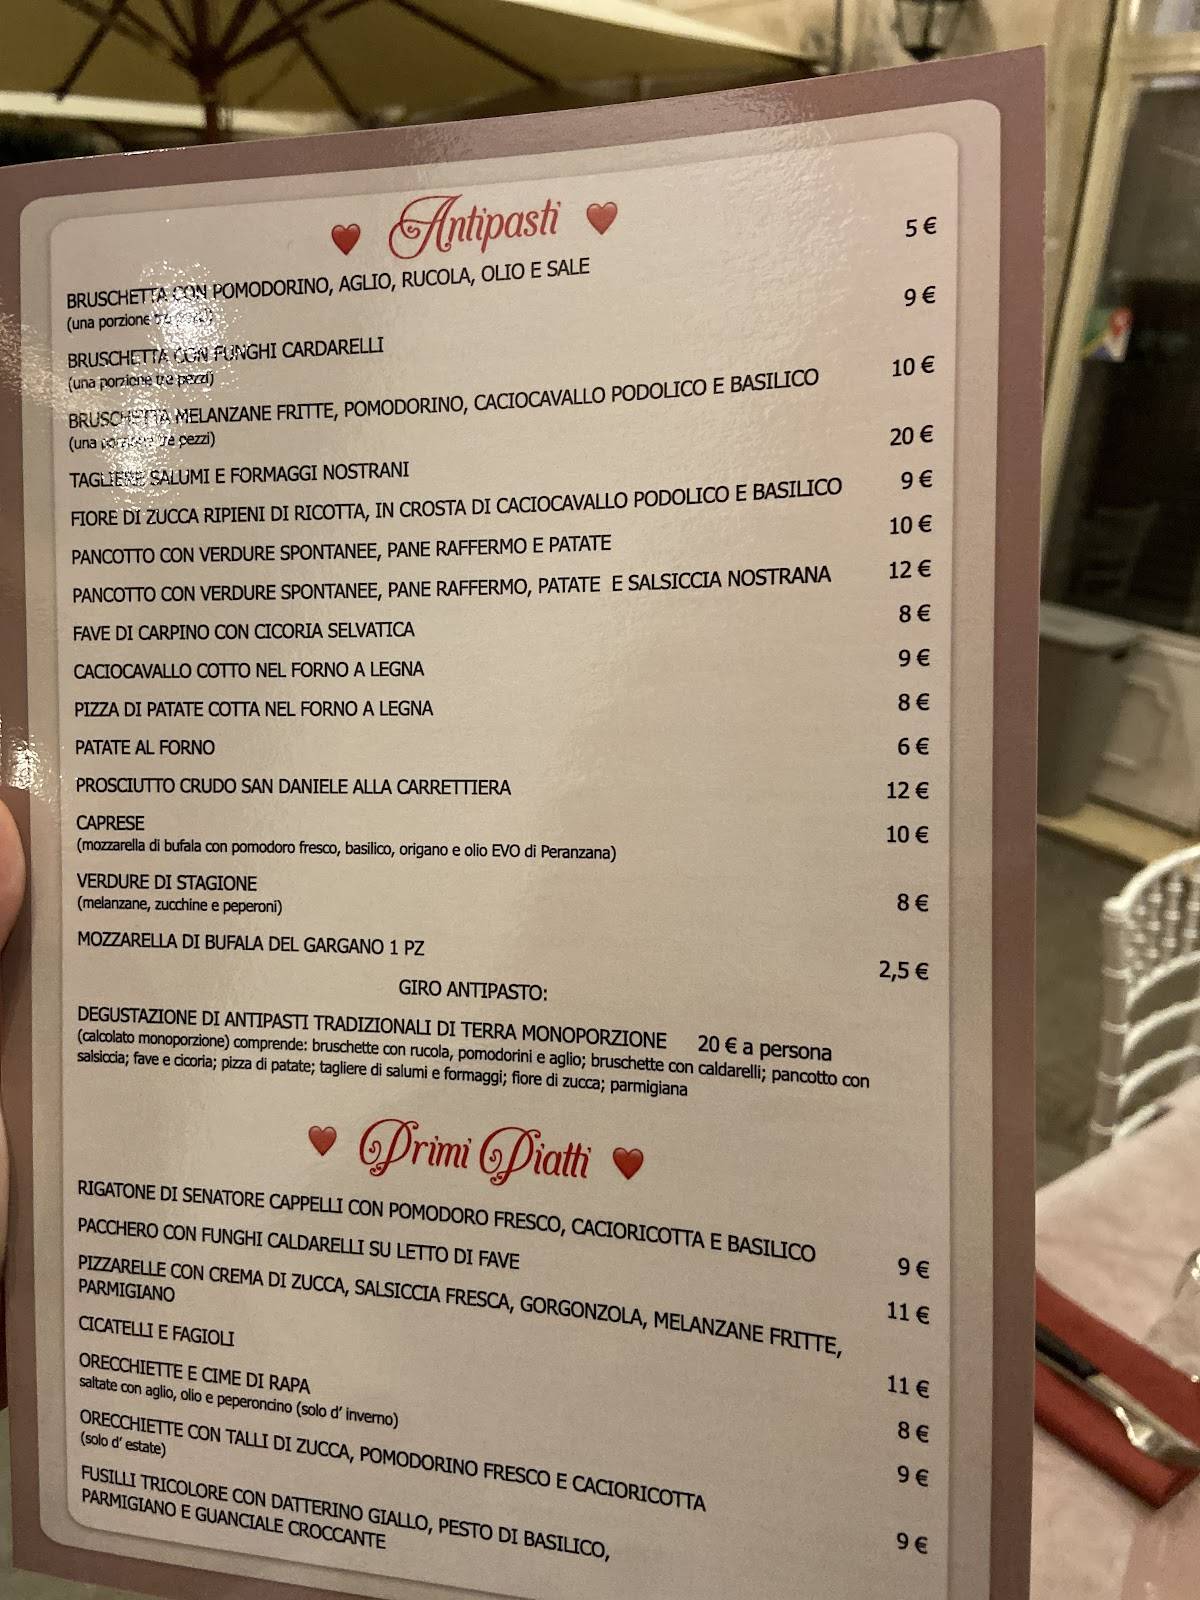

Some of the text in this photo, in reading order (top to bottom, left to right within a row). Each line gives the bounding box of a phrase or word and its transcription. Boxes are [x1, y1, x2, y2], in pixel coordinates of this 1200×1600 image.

[388, 193, 562, 260] Antipasti
[905, 215, 938, 238] 5 €
[66, 256, 591, 310] BRUSCHETTA CON POMODORINO, AGLIO, RUCOLA, OLIO E SALE
[891, 354, 935, 378] 10 €
[70, 476, 843, 527] FIORE DI ZUCCA RIPIENI DI RICOTTA, IN CROSTA DI CACIOCAVALLO PODOLICO E BASILICO
[888, 558, 932, 580] 12 €
[72, 620, 416, 642] FAVE DI CARPINO CON CICORIA SELVATICA
[74, 699, 434, 718] PIZZA DI PATATE COTTA NEL FORNO A LEGNA
[897, 692, 930, 712] 8 €
[75, 776, 512, 796] PROSCIUTTO CRUDO SAN DANIELE ALLA CARRETTIERA
[75, 814, 145, 832] CAPRESE
[76, 836, 617, 864] (mozzarella di bufala con pomodoro fresco, basilico, origano e olio EVO di Peranzana)
[77, 894, 283, 917] (melanzane, zucchine e peperoni)
[77, 929, 425, 957] MOZZARELLA DI BUFALA DEL GARGANO 1 PZ
[878, 959, 929, 983] 2,5 €
[398, 978, 548, 1002] GIRO ANTIPASTO:
[77, 1004, 668, 1050] DEGUSTAZIONE DI ANTIPASTI TRADIZIONALI DI TERRA MONOPORZIONE
[697, 1034, 832, 1062] 20 € a persona
[76, 1048, 688, 1098] salsiccia; fave e cicoria; pizza di patate; tagliere di salumi e formaggi; fiore di zucca; parmigiana
[359, 1118, 592, 1186] Primi Piatti
[77, 1178, 816, 1263] RIGATONE DI SENATORE CAPPELLI CON POMODORO FRESCO, CACIORICOTTA E BASILICO
[77, 1277, 176, 1303] PARMIGIANO
[77, 1253, 842, 1359] PIZZARELLE CON CREMA DI ZUCCA, SALSICCIA FRESCA, GORGONZOLA, MELANZANE FRITTE,
[887, 1300, 930, 1326] 11 €
[78, 1351, 311, 1395] ORECCHIETTE E CIME DI RAPA
[80, 1463, 610, 1563] FUSILLI TRICOLORE CON DATTERINO GIALLO, PESTO DI BASILICO,
[81, 1487, 387, 1550] PARMIGIANO E GUANCIALE CROCCANTE
[896, 1531, 929, 1555] 9 €
